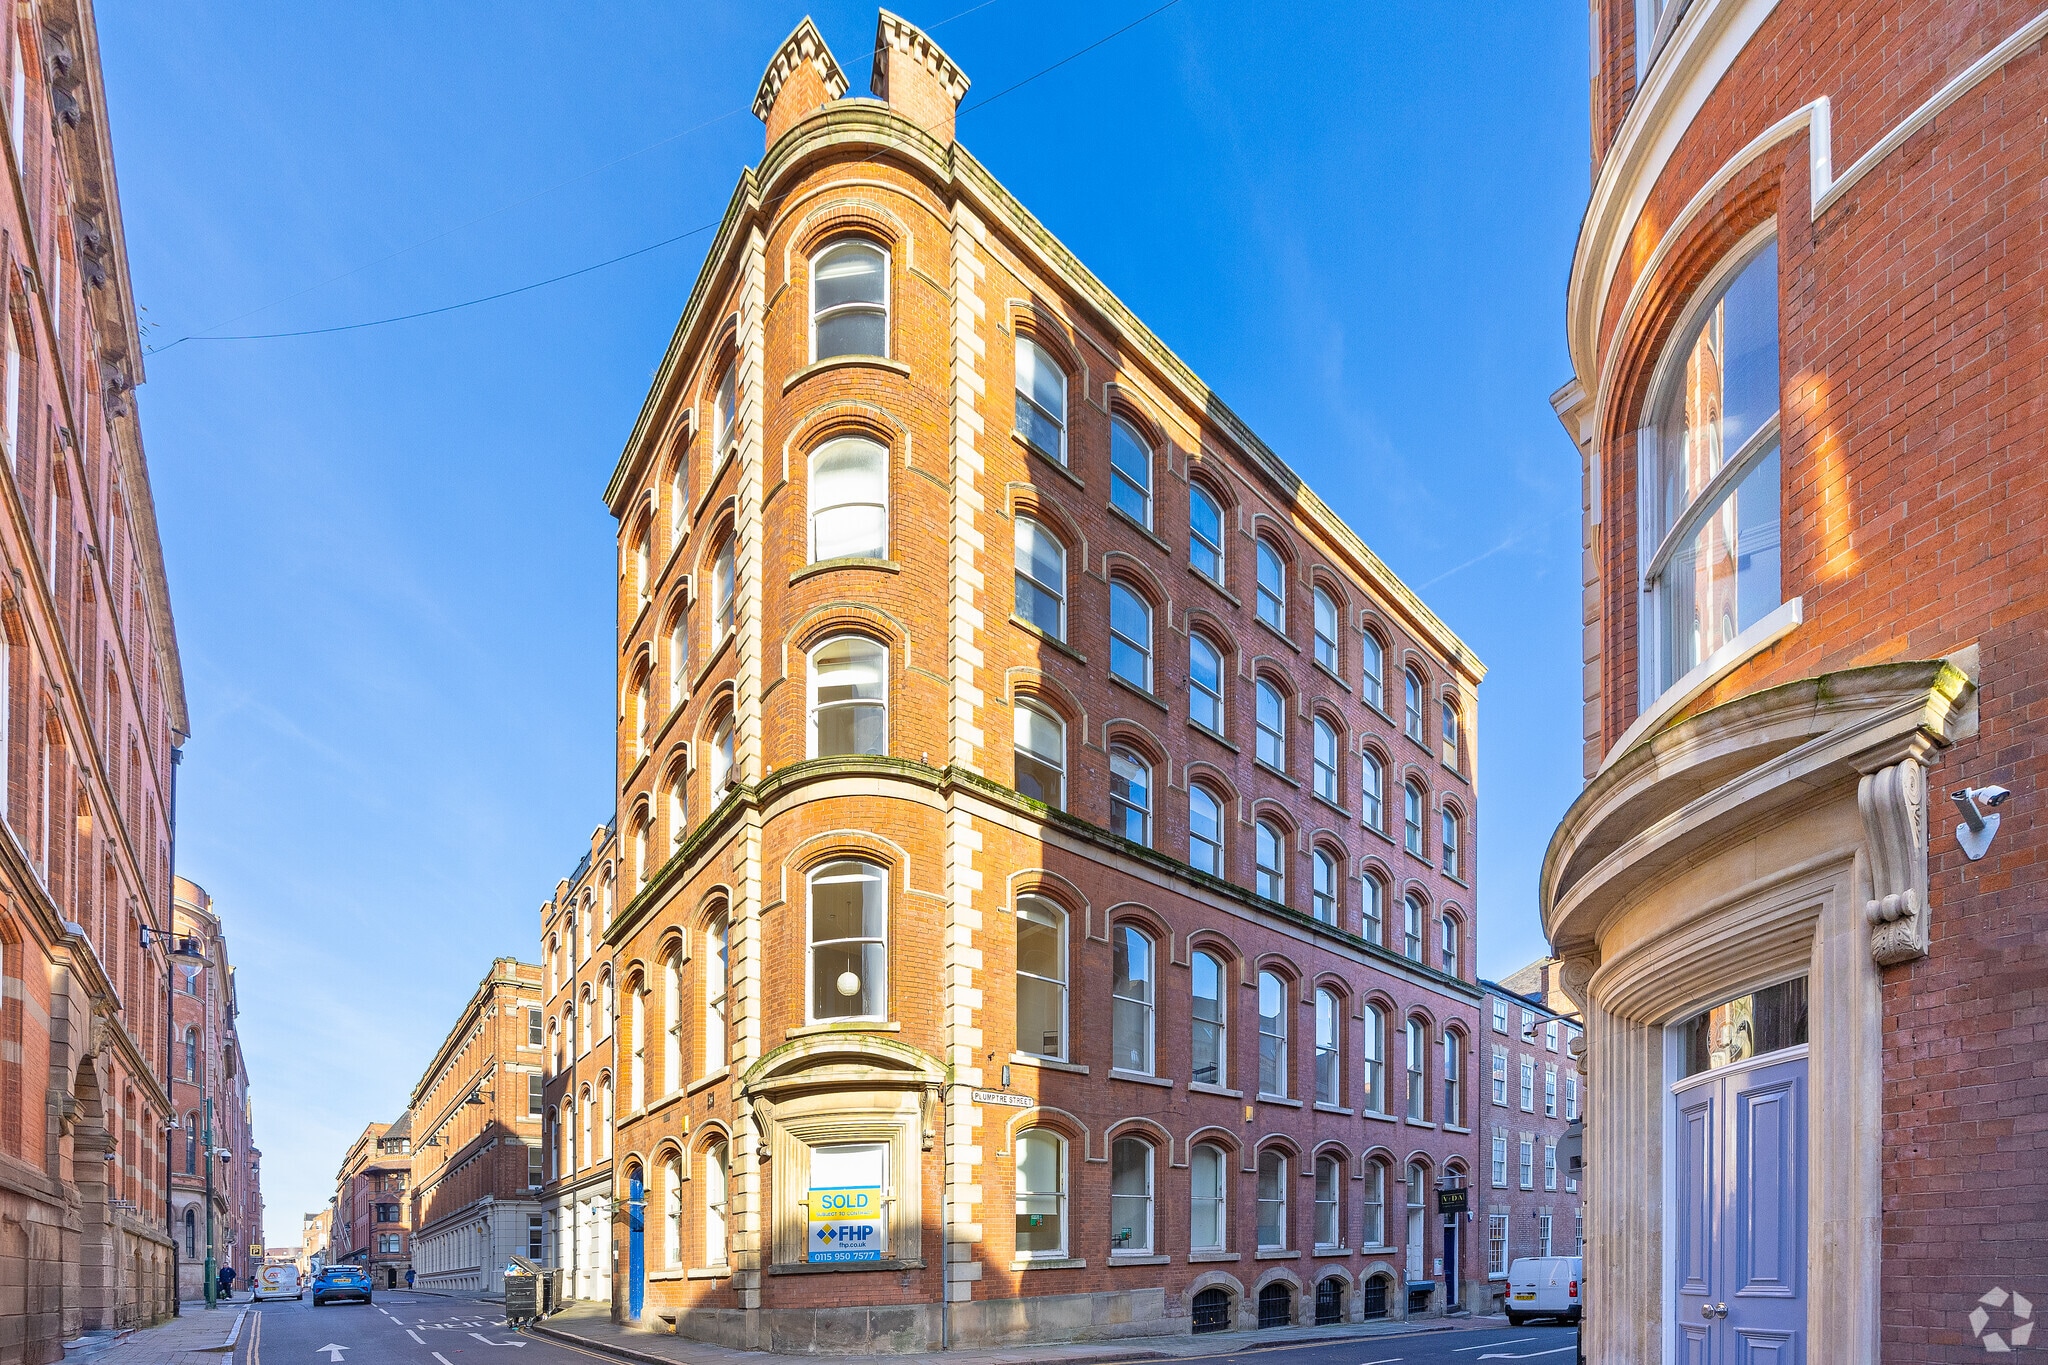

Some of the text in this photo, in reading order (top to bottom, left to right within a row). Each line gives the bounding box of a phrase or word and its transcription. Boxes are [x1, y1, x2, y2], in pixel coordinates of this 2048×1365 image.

[974, 1092, 1032, 1106] PLUMPTRE STREET
[822, 1193, 868, 1209] SOLD
[838, 1225, 874, 1241] FHP
[814, 1252, 875, 1261] 0115 950 7577
